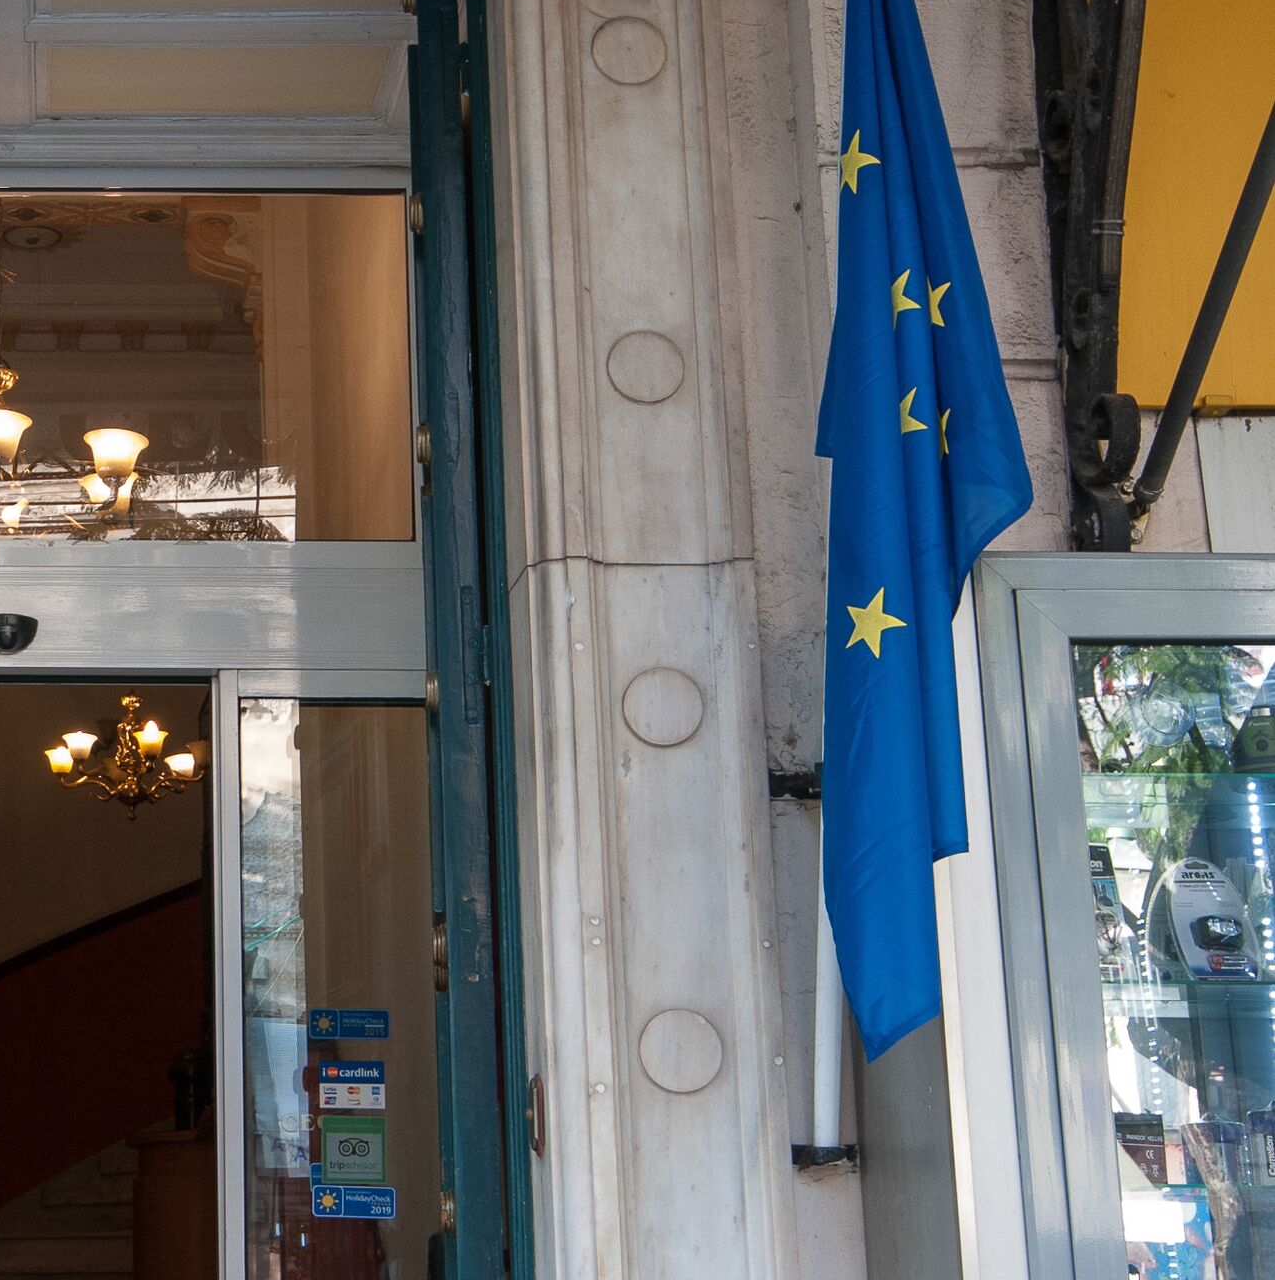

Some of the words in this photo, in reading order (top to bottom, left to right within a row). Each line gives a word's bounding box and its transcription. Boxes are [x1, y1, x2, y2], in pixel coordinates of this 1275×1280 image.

[339, 1067, 380, 1078] cardlink
[329, 1161, 376, 1170] tripadvisor
[345, 1194, 391, 1204] HolidayCheck
[371, 1205, 392, 1215] 2019
